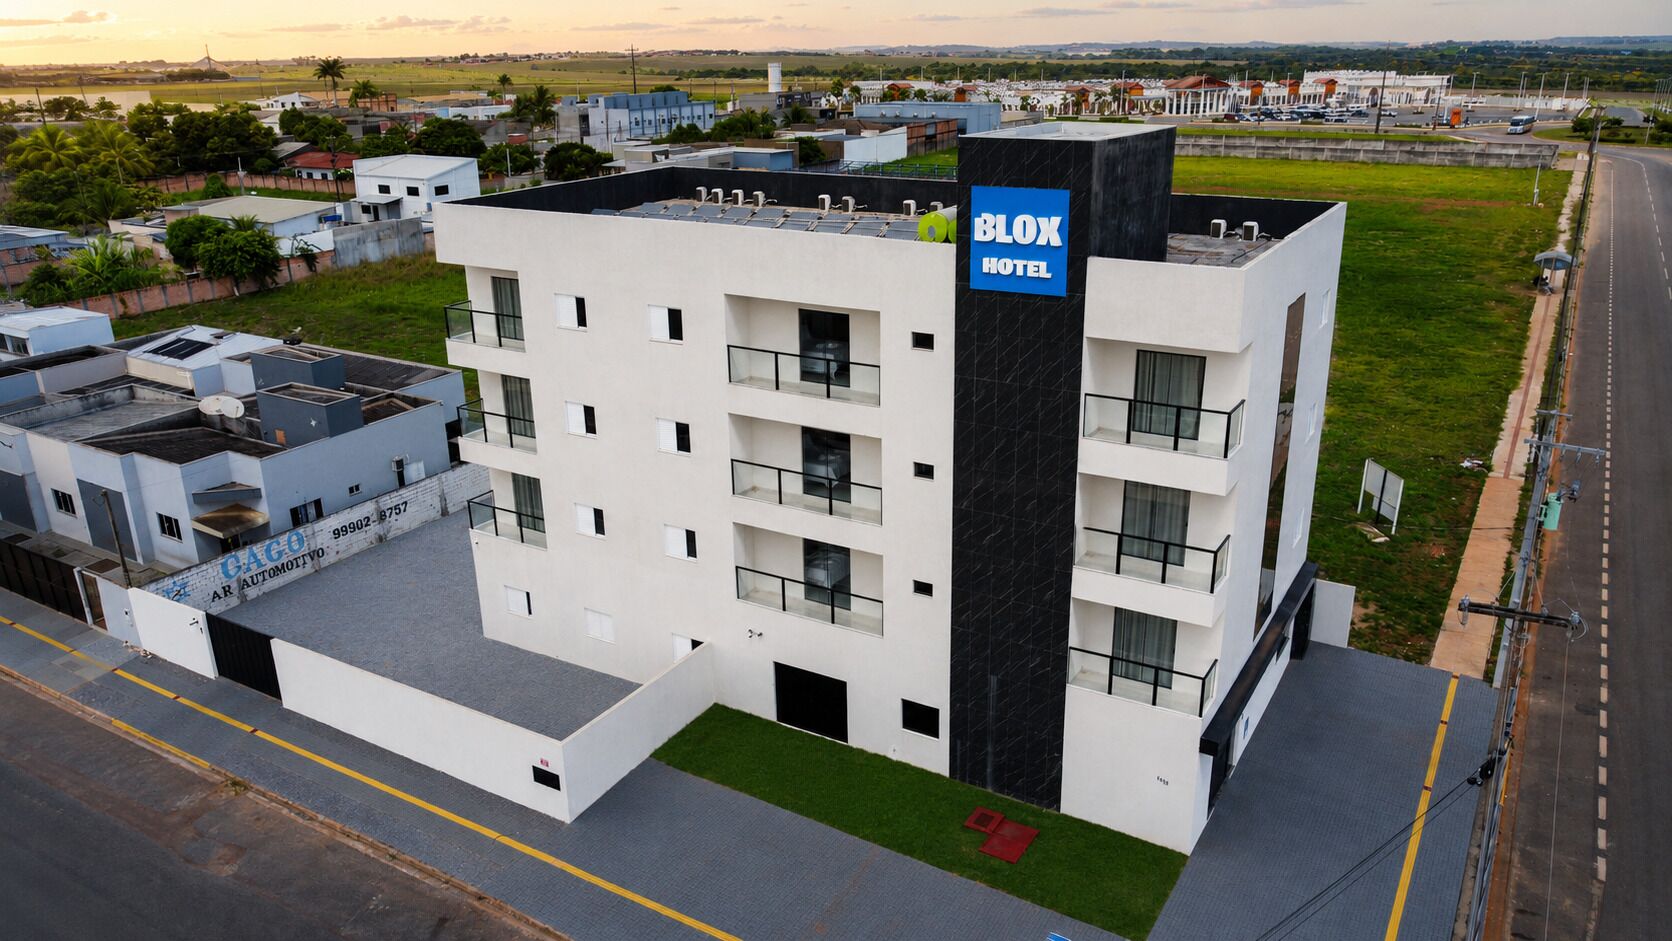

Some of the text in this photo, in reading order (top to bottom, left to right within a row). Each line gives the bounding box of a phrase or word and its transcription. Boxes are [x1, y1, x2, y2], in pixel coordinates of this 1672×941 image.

[974, 213, 1063, 247] BLOX
[982, 257, 1052, 279] HOTEL
[211, 547, 325, 602] AR AUTOMOTIVO
